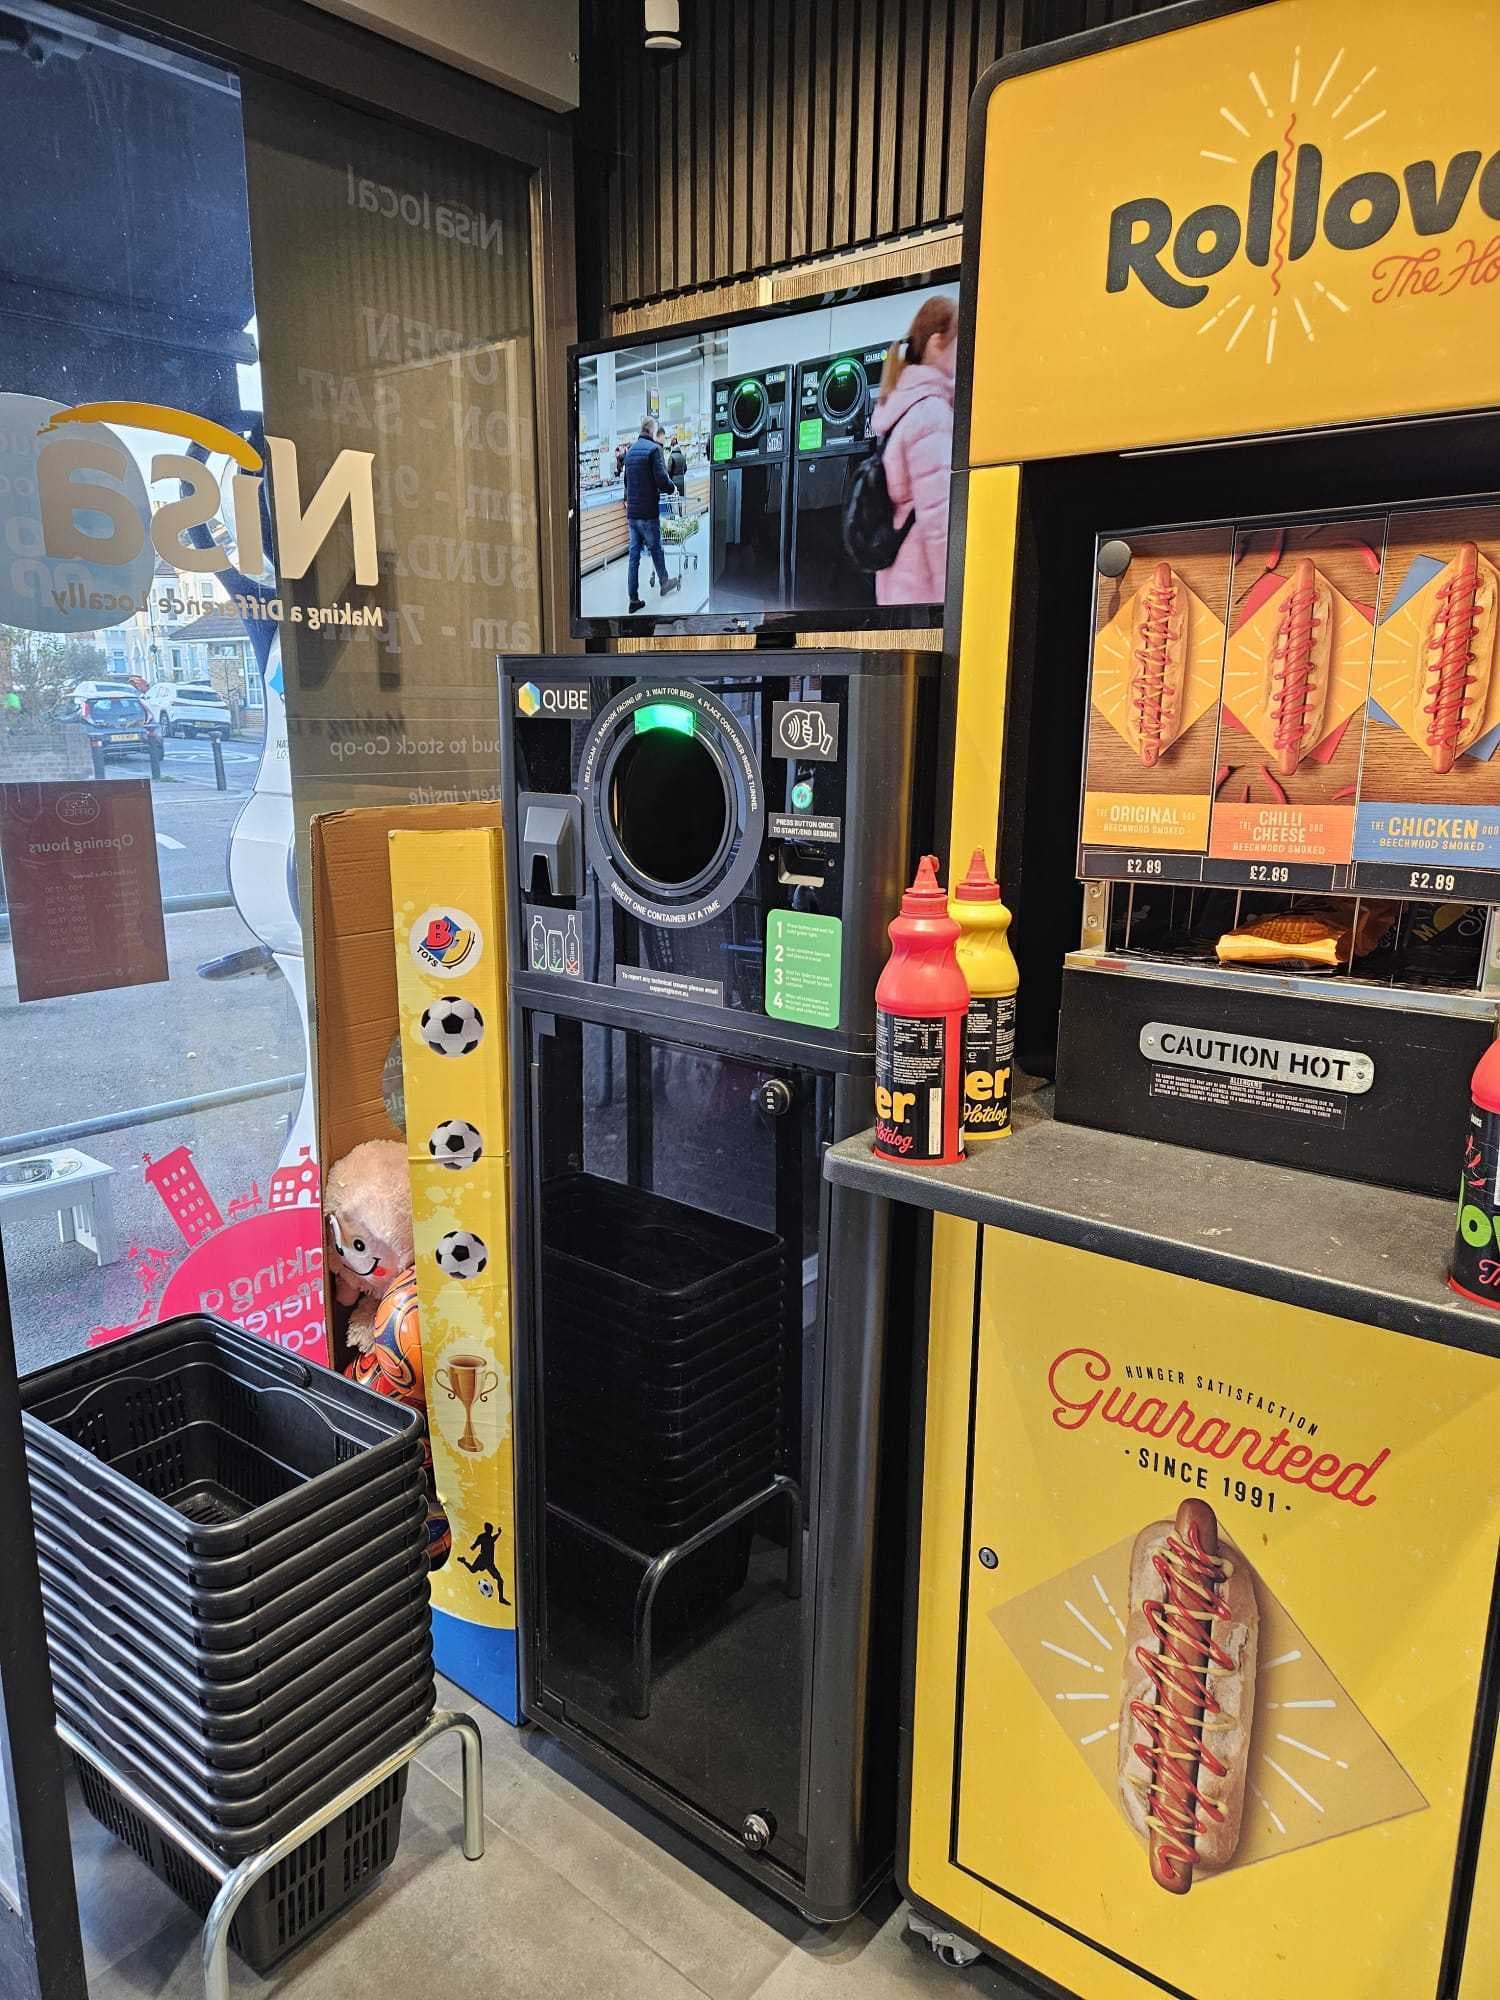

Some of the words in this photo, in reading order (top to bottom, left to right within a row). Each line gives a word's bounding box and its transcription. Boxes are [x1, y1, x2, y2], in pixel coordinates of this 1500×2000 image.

[542, 689, 588, 711] QUBE
[652, 687, 667, 696] WAIT
[667, 687, 679, 696] FOR
[680, 690, 695, 699] BEEP
[703, 701, 722, 720] PLACE
[720, 717, 745, 754] CONTAINER
[749, 780, 758, 811] TUNNEL
[776, 818, 794, 826] PRESS
[795, 820, 818, 828] BUTTON
[818, 822, 835, 830] ONCE
[1110, 805, 1180, 825] ORIGINAL
[1259, 810, 1303, 826] CHILLI
[813, 830, 838, 839] SESSION
[1104, 822, 1150, 834] BEECHWOOD
[1152, 824, 1185, 836] SMOKED
[1252, 826, 1305, 843] CHEESE
[1371, 820, 1385, 831] THE
[1388, 816, 1479, 840] CHICKEN
[1232, 841, 1287, 854] BEECHWOOD
[1287, 843, 1326, 856] SMOKED
[1379, 837, 1440, 850] BEECHWOOD
[1442, 839, 1485, 852] SMOKED
[1127, 858, 1162, 875] £2.89
[1249, 865, 1289, 883] £2.89
[1409, 871, 1455, 891] £2.89
[611, 881, 632, 905] INSERT
[632, 902, 647, 915] ONE
[647, 910, 687, 923] CONTAINER
[687, 912, 696, 921] AT
[697, 911, 703, 919] A
[703, 900, 721, 915] TIME
[777, 921, 783, 939] 1
[416, 945, 439, 968] TOYS
[774, 944, 784, 962] 2
[774, 968, 783, 985] 3
[773, 992, 784, 1009] 4
[1160, 1033, 1280, 1070] CAUTION
[1288, 1052, 1351, 1082] HOT
[1125, 1365, 1186, 1385] HUNGER
[1196, 1375, 1320, 1437] SATISFACTION
[1048, 1347, 1391, 1507] Guaranteed
[1138, 1447, 1209, 1490] SINCE
[1223, 1476, 1276, 1514] 1991
